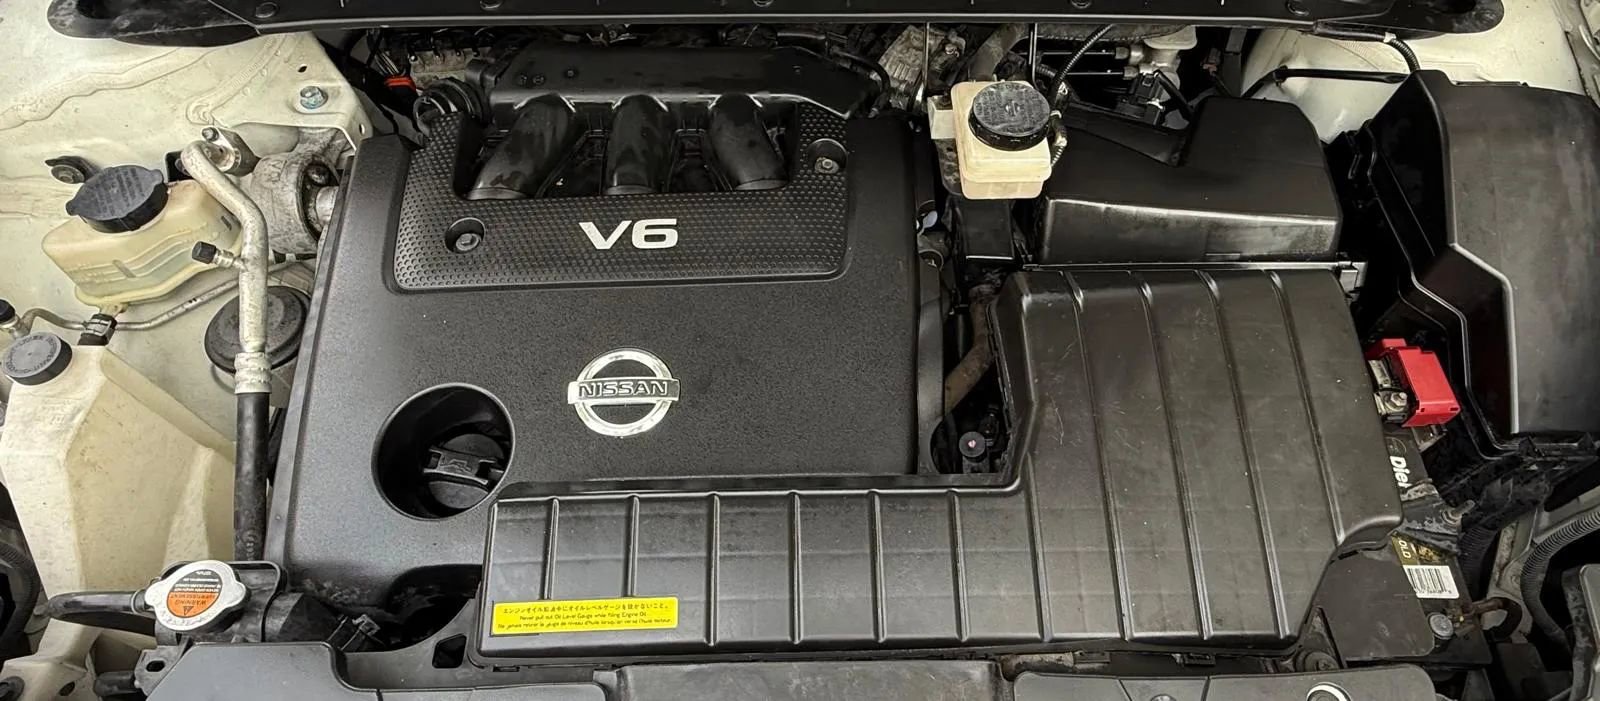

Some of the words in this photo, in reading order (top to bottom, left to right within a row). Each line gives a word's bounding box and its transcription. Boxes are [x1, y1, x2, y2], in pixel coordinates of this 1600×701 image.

[579, 218, 678, 249] V6
[578, 381, 668, 397] NISSAN
[1397, 537, 1412, 559] OLD
